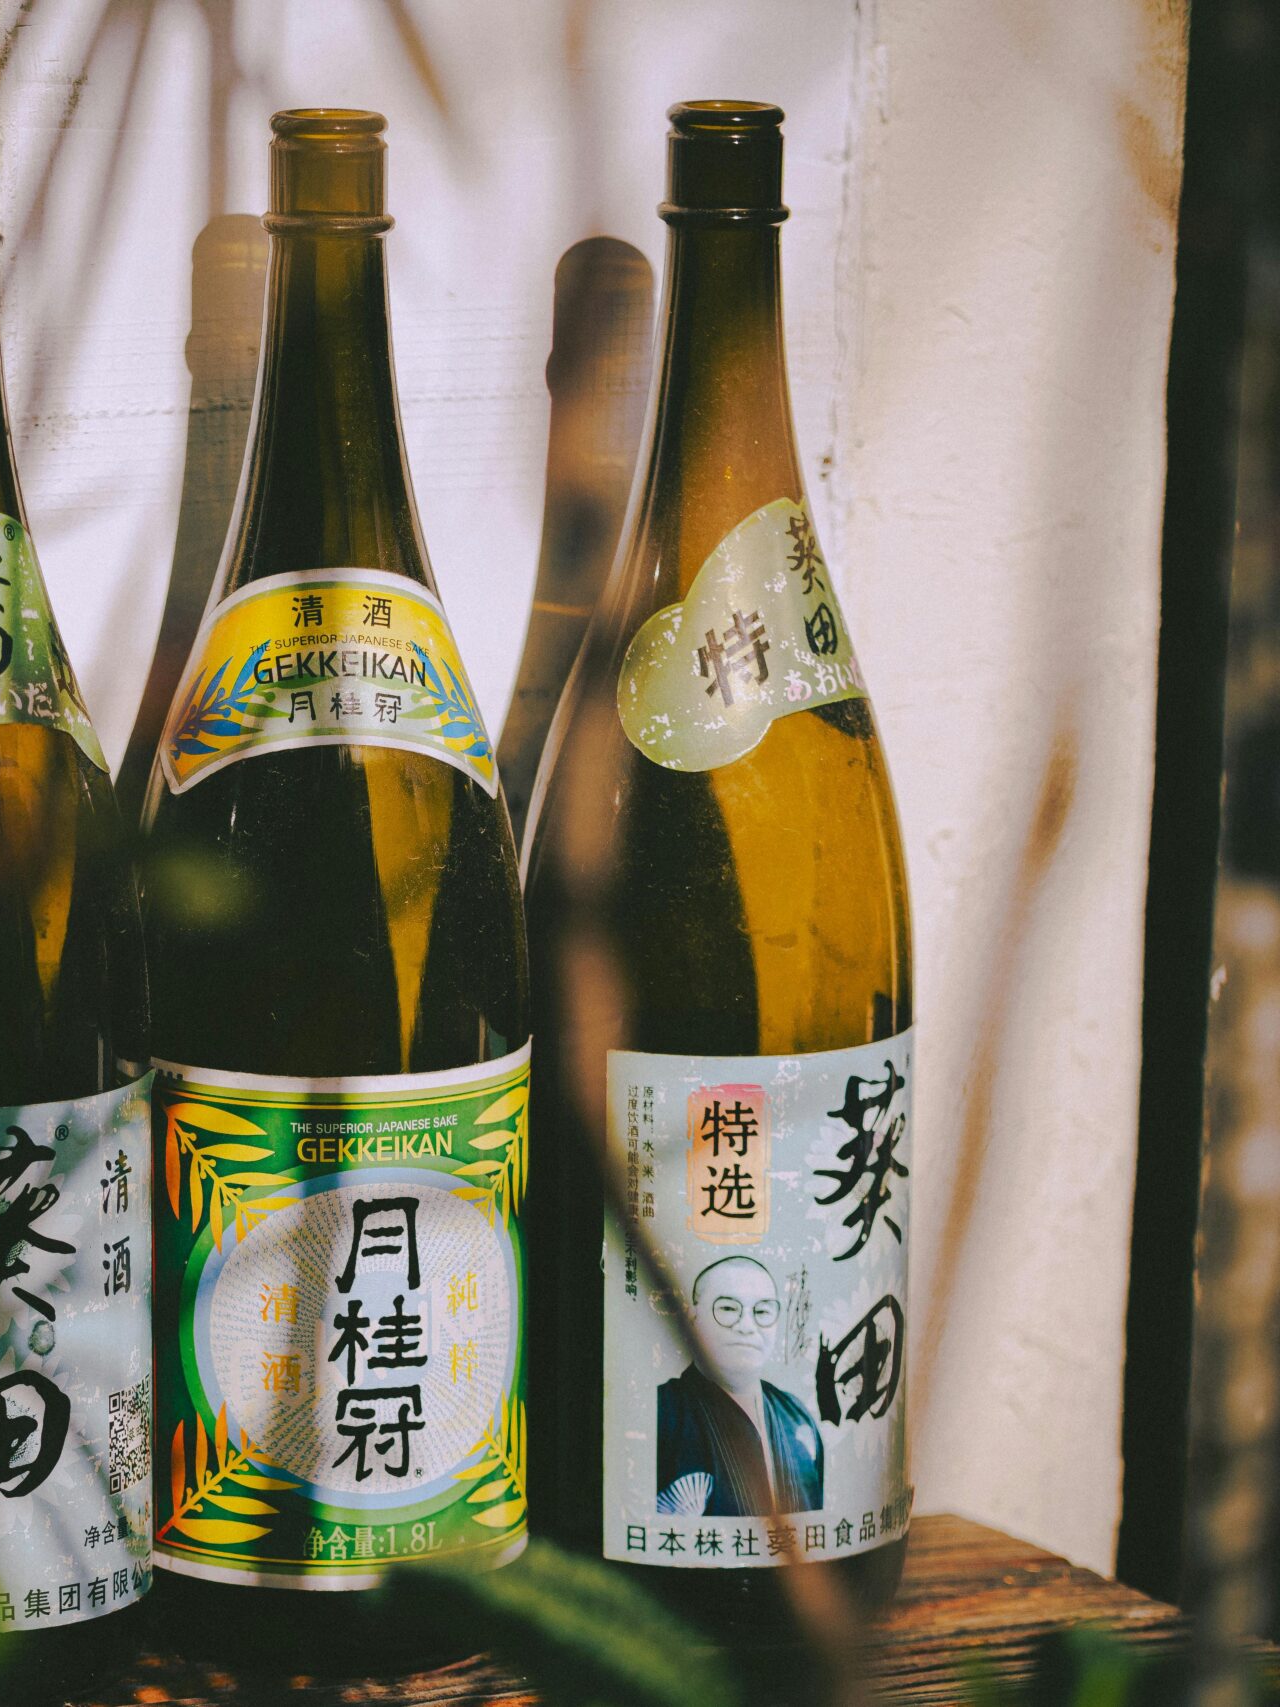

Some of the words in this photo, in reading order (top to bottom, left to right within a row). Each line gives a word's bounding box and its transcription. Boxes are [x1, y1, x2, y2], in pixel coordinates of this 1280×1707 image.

[249, 644, 271, 656] THE
[275, 634, 337, 650] SUPERIOR
[341, 634, 402, 649] JAPANESE
[405, 642, 430, 657] SAKE
[292, 595, 392, 629] 清酒
[253, 650, 426, 687] GEKKEIKAN
[697, 609, 770, 708] 特
[288, 690, 402, 724] 月桂冠
[290, 1122, 312, 1134] THE
[316, 1122, 373, 1134] SUPERIOR
[376, 1117, 430, 1133] JAPANESE
[433, 1114, 458, 1127] SAKE
[297, 1130, 453, 1163] GEKKEIKAN
[700, 1101, 759, 1219] 特选
[101, 1150, 132, 1296] 清酒
[813, 1060, 910, 1428] 葵田
[259, 1282, 302, 1394] 清酒
[327, 1198, 428, 1482] 月桂冠
